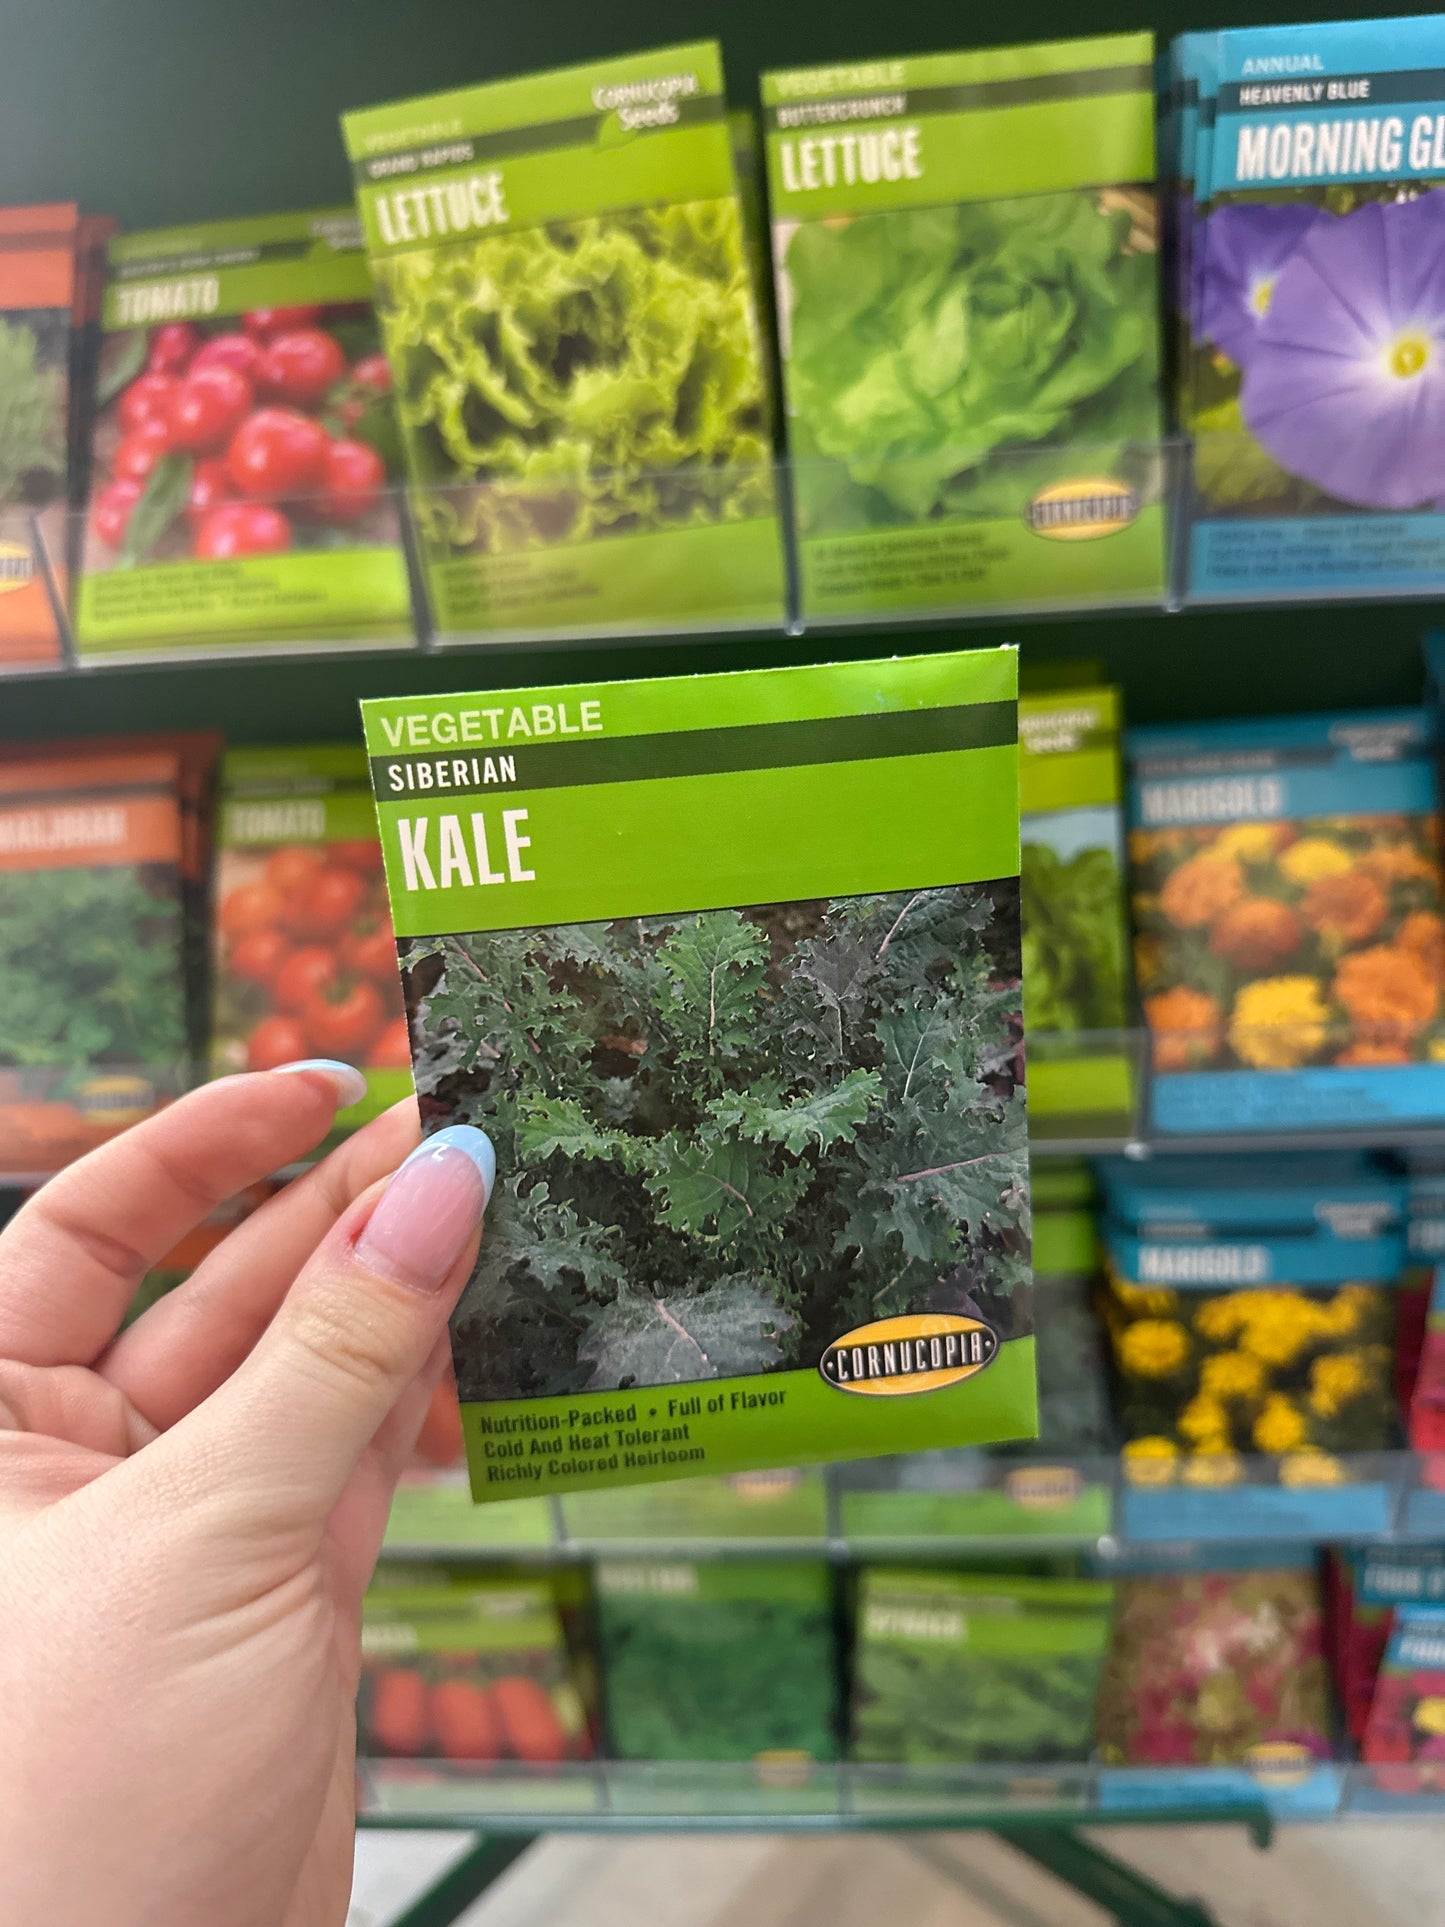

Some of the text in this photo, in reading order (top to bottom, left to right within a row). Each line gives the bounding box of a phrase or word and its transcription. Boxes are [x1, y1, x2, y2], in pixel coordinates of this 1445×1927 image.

[1242, 54, 1324, 75] ANNUAL
[1239, 79, 1371, 106] HEAVENLY BLUE
[780, 127, 924, 192] LETTUCE
[1236, 117, 1404, 181] MORNING
[375, 171, 510, 245] LETTUCE
[118, 275, 219, 325] TOMATO
[380, 700, 604, 747] VEGETABLE
[388, 755, 517, 792] SIBERIAN
[1141, 778, 1282, 823] MARIGOLD
[397, 808, 536, 891] KALE
[1137, 1245, 1269, 1281] MARIGOLD
[837, 1332, 983, 1381] CORNUCOPIA
[481, 1389, 787, 1434] Nutrition-Packed Full of Flavor
[484, 1423, 690, 1459] Cold And Heat Tolerant
[487, 1445, 706, 1483] Richly Colored Heirloom
